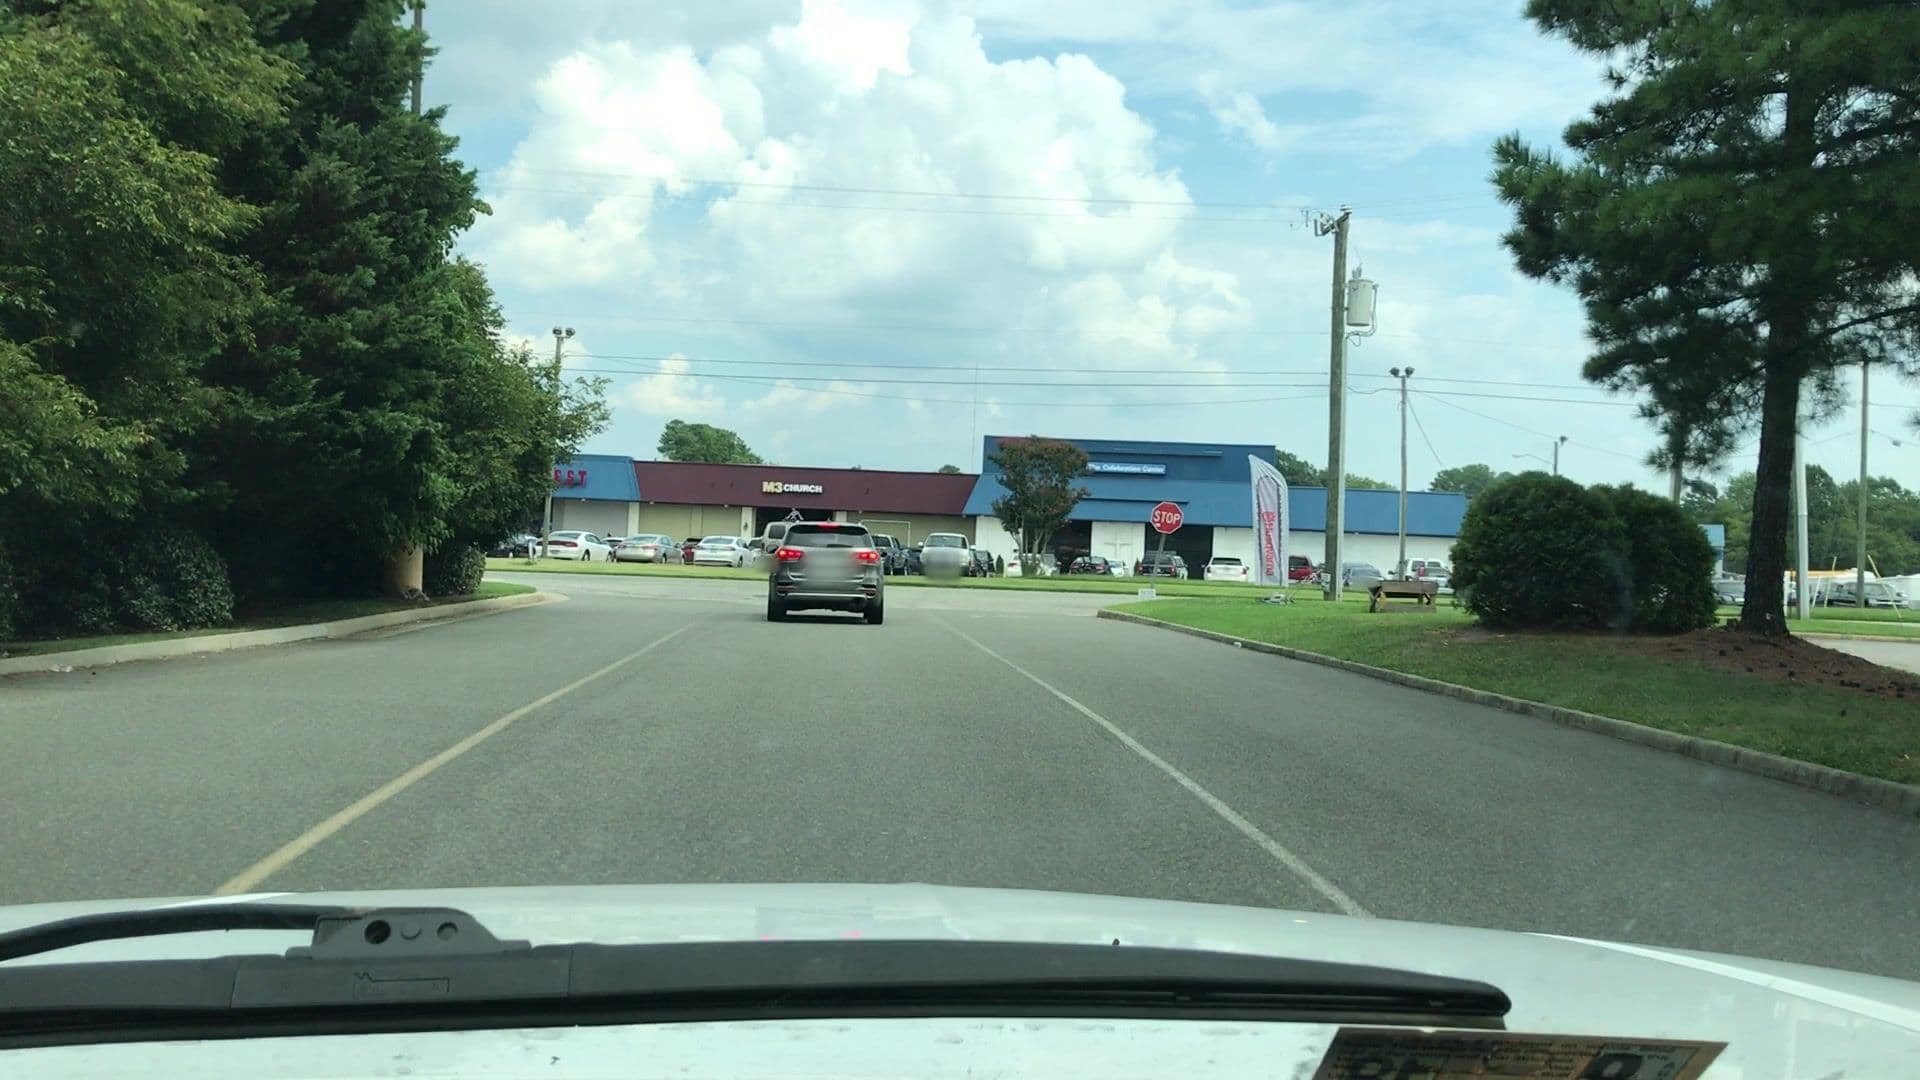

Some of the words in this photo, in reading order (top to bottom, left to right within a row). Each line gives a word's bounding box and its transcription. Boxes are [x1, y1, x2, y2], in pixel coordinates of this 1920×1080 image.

[762, 482, 783, 493] M3
[783, 484, 823, 493] CHURCH
[1153, 510, 1181, 524] STOP
